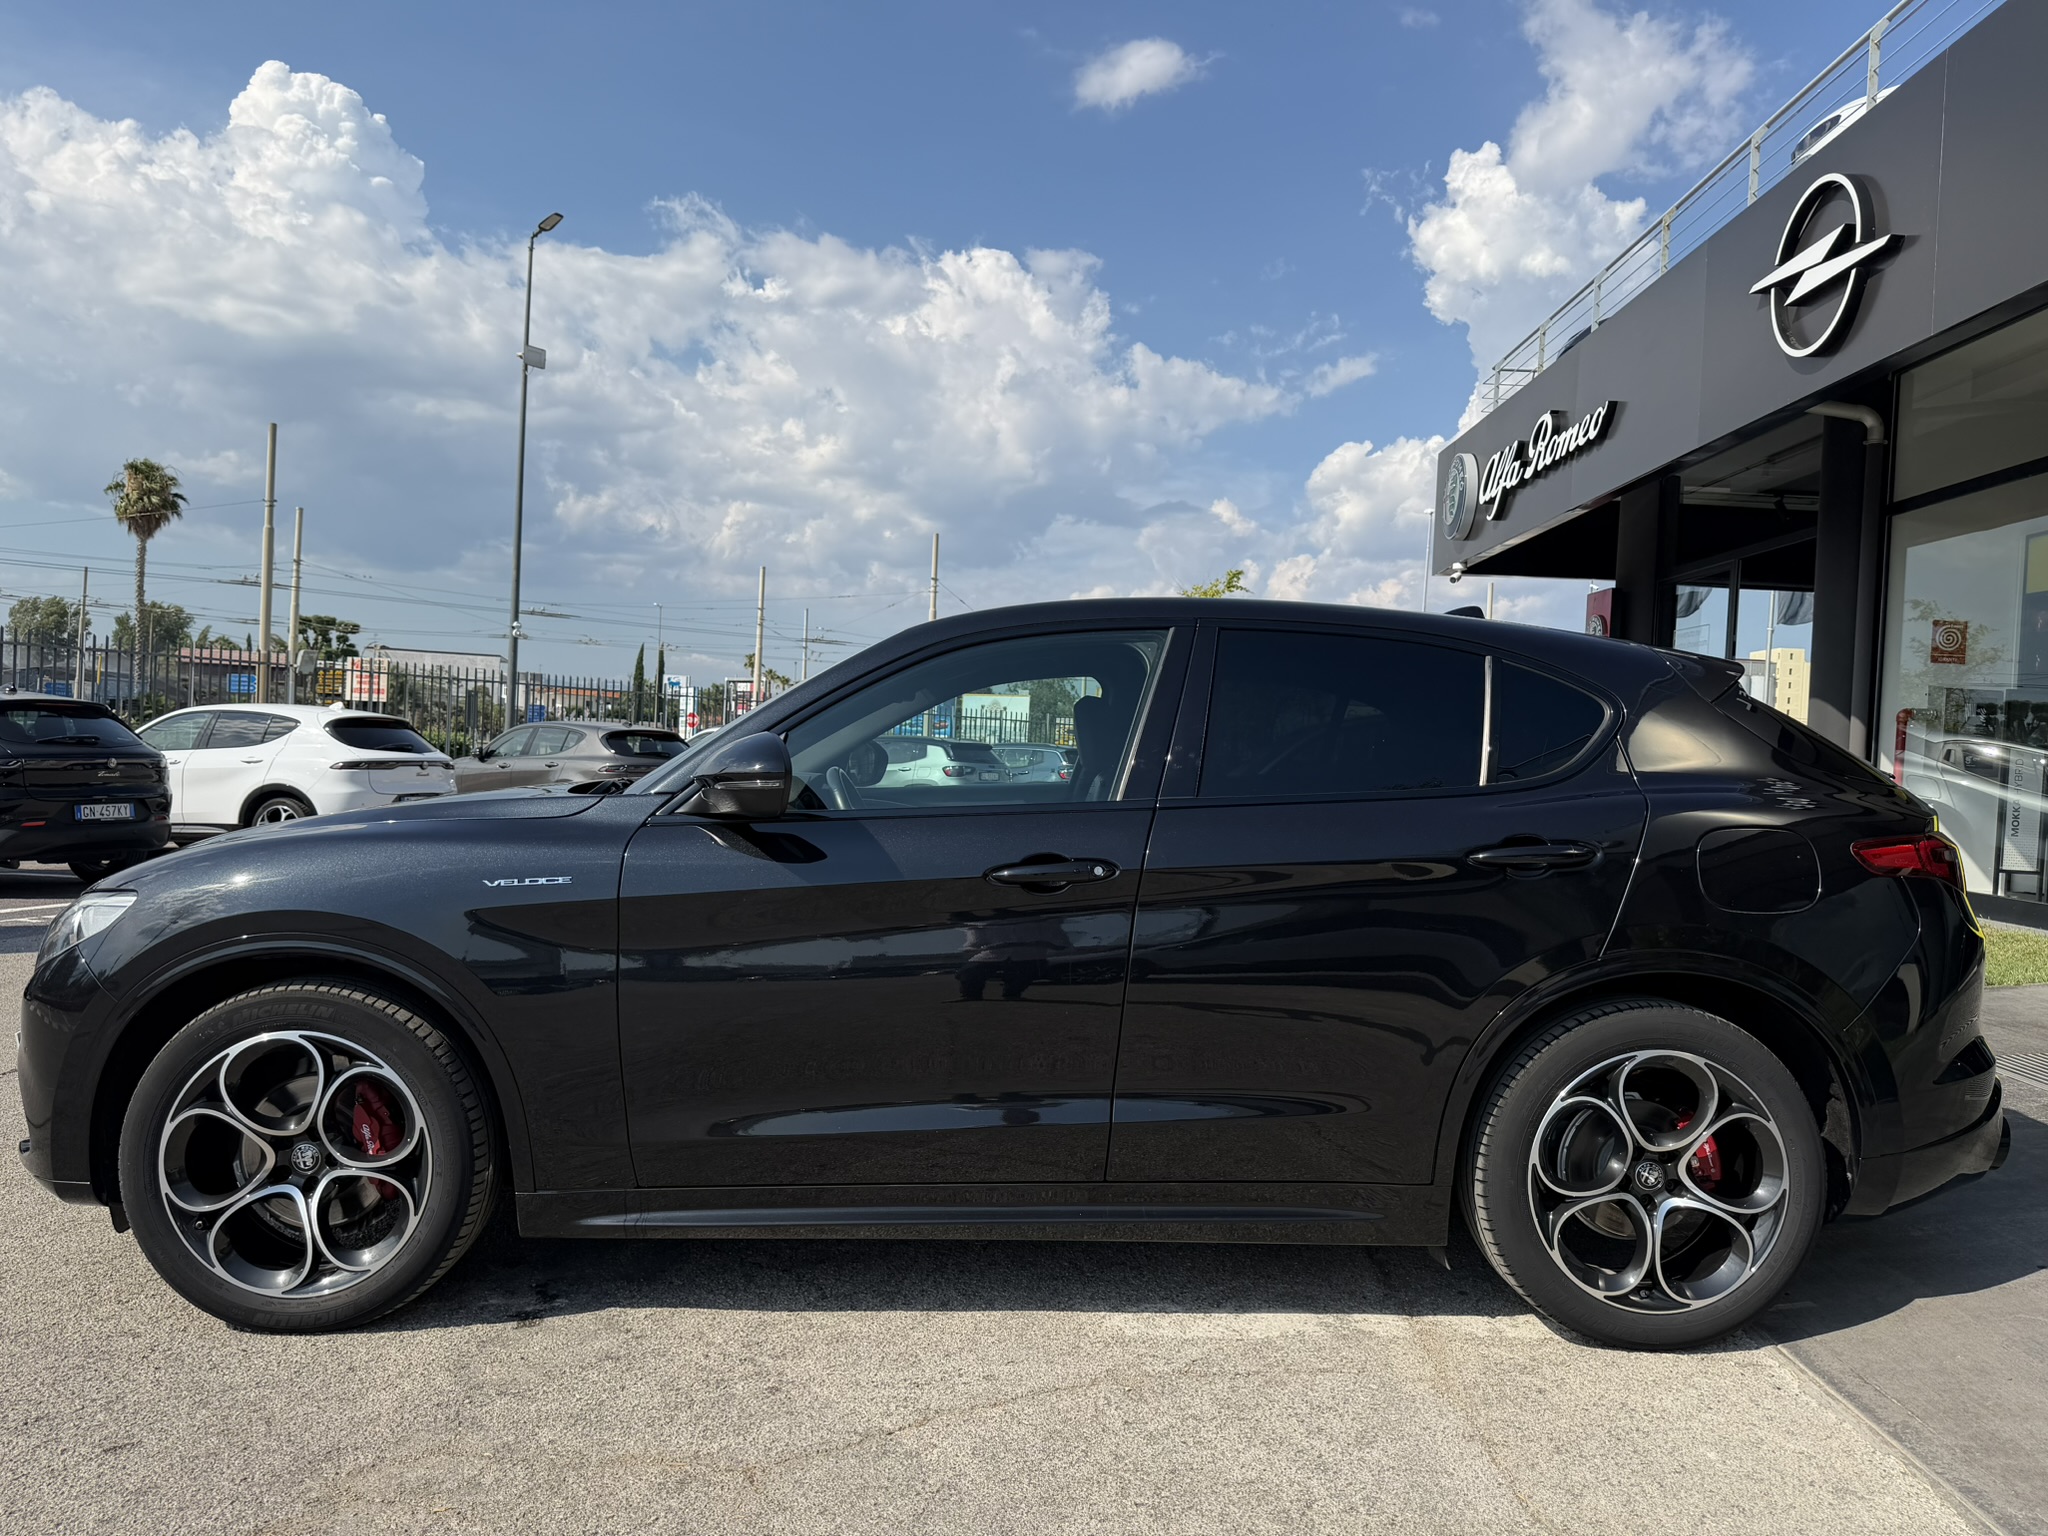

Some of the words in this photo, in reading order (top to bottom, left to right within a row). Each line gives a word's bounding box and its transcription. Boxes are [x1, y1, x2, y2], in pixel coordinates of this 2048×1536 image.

[1479, 440, 1523, 521] Alfa
[1524, 400, 1608, 479] Romeo
[2013, 758, 2025, 795] HYBRID
[82, 806, 96, 818] GN
[100, 804, 128, 817] 457KY
[2010, 799, 2021, 837] MOKKA
[482, 876, 572, 887] VELOCE
[229, 1003, 335, 1027] MICHELIN
